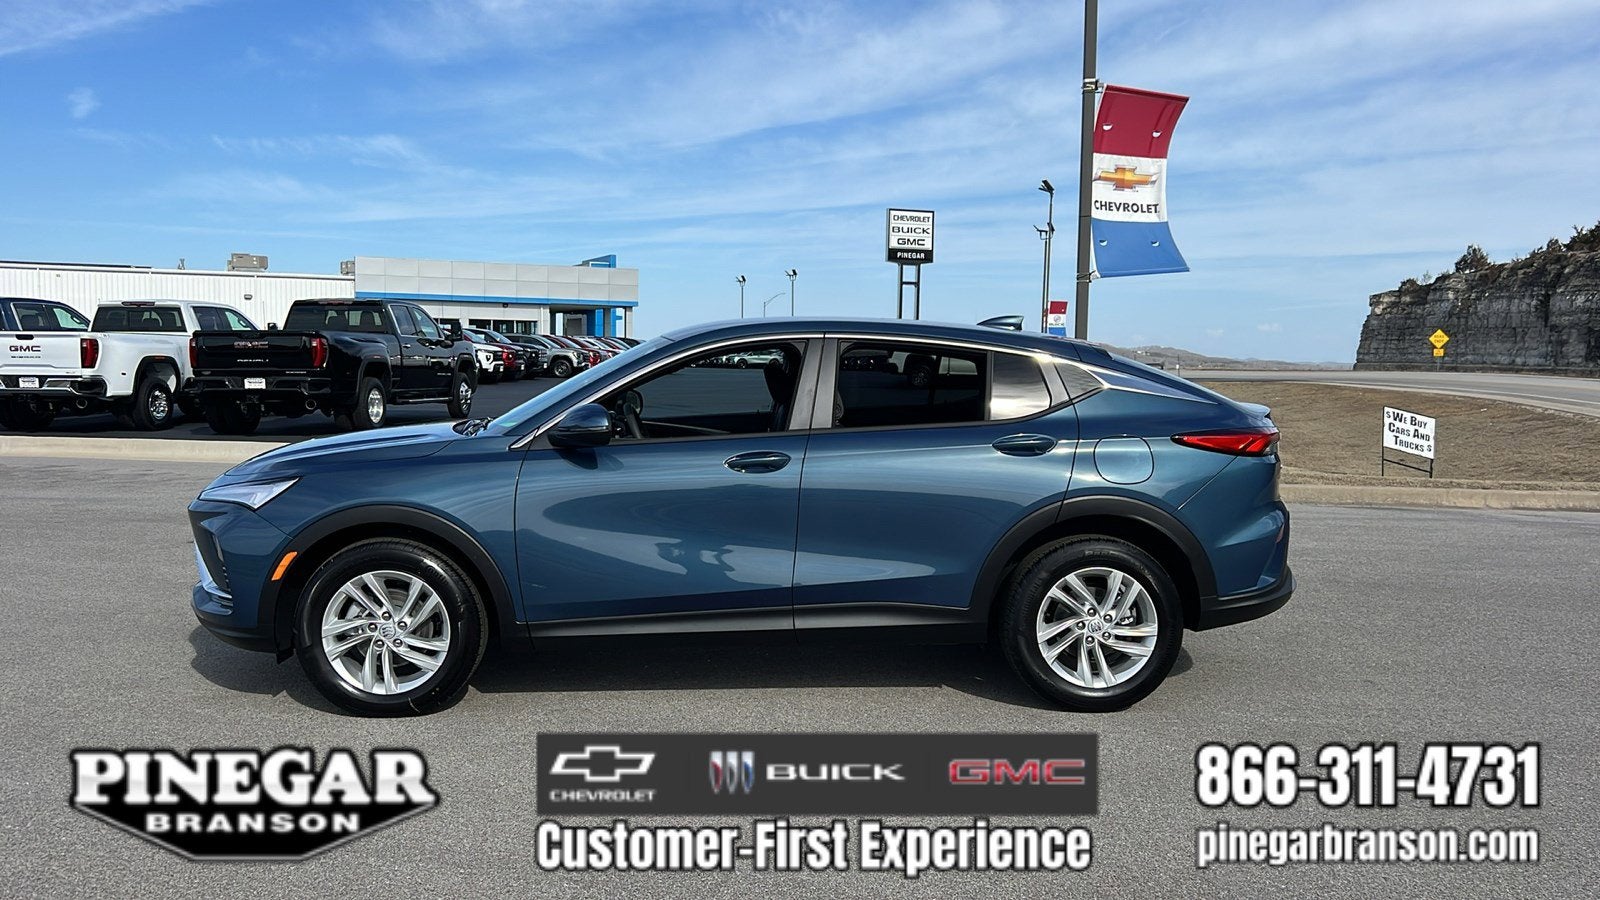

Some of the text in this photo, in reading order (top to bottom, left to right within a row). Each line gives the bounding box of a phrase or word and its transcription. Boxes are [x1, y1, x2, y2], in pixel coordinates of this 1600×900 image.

[1093, 200, 1159, 214] CHEVROLET
[893, 215, 931, 223] CHEVROLET
[892, 226, 931, 235] BUICK
[896, 237, 926, 246] GMC
[896, 251, 925, 259] PINEGAR
